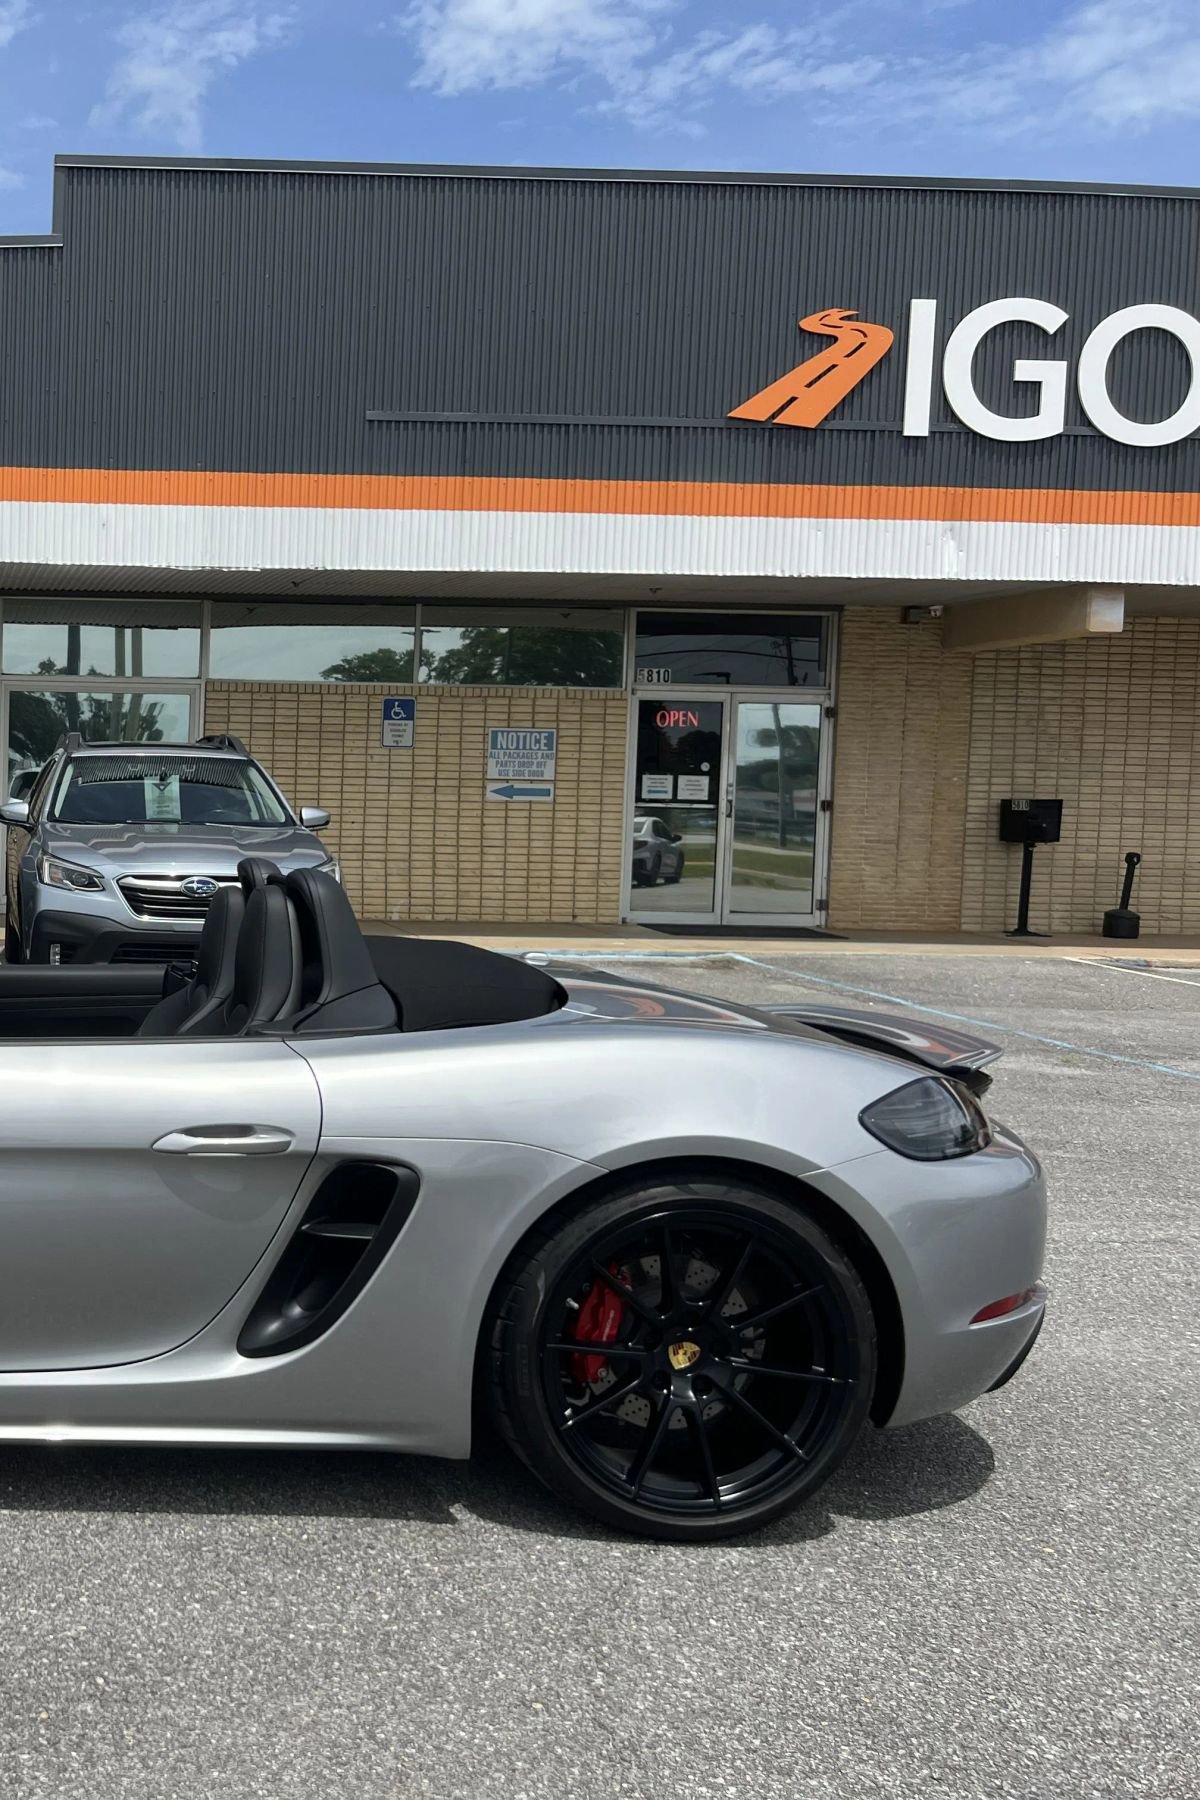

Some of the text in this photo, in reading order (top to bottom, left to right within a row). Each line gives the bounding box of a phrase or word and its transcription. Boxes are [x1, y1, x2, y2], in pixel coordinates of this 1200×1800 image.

[903, 297, 1200, 447] IGO
[637, 669, 670, 683] 5810
[656, 710, 699, 728] OPEN
[497, 731, 549, 750] NOTICE
[489, 751, 501, 759] ALL
[503, 751, 539, 760] PACKAGES
[496, 760, 516, 768] PARTS
[518, 760, 534, 769] DROP
[498, 769, 510, 777] USE
[512, 769, 527, 777] SIDE
